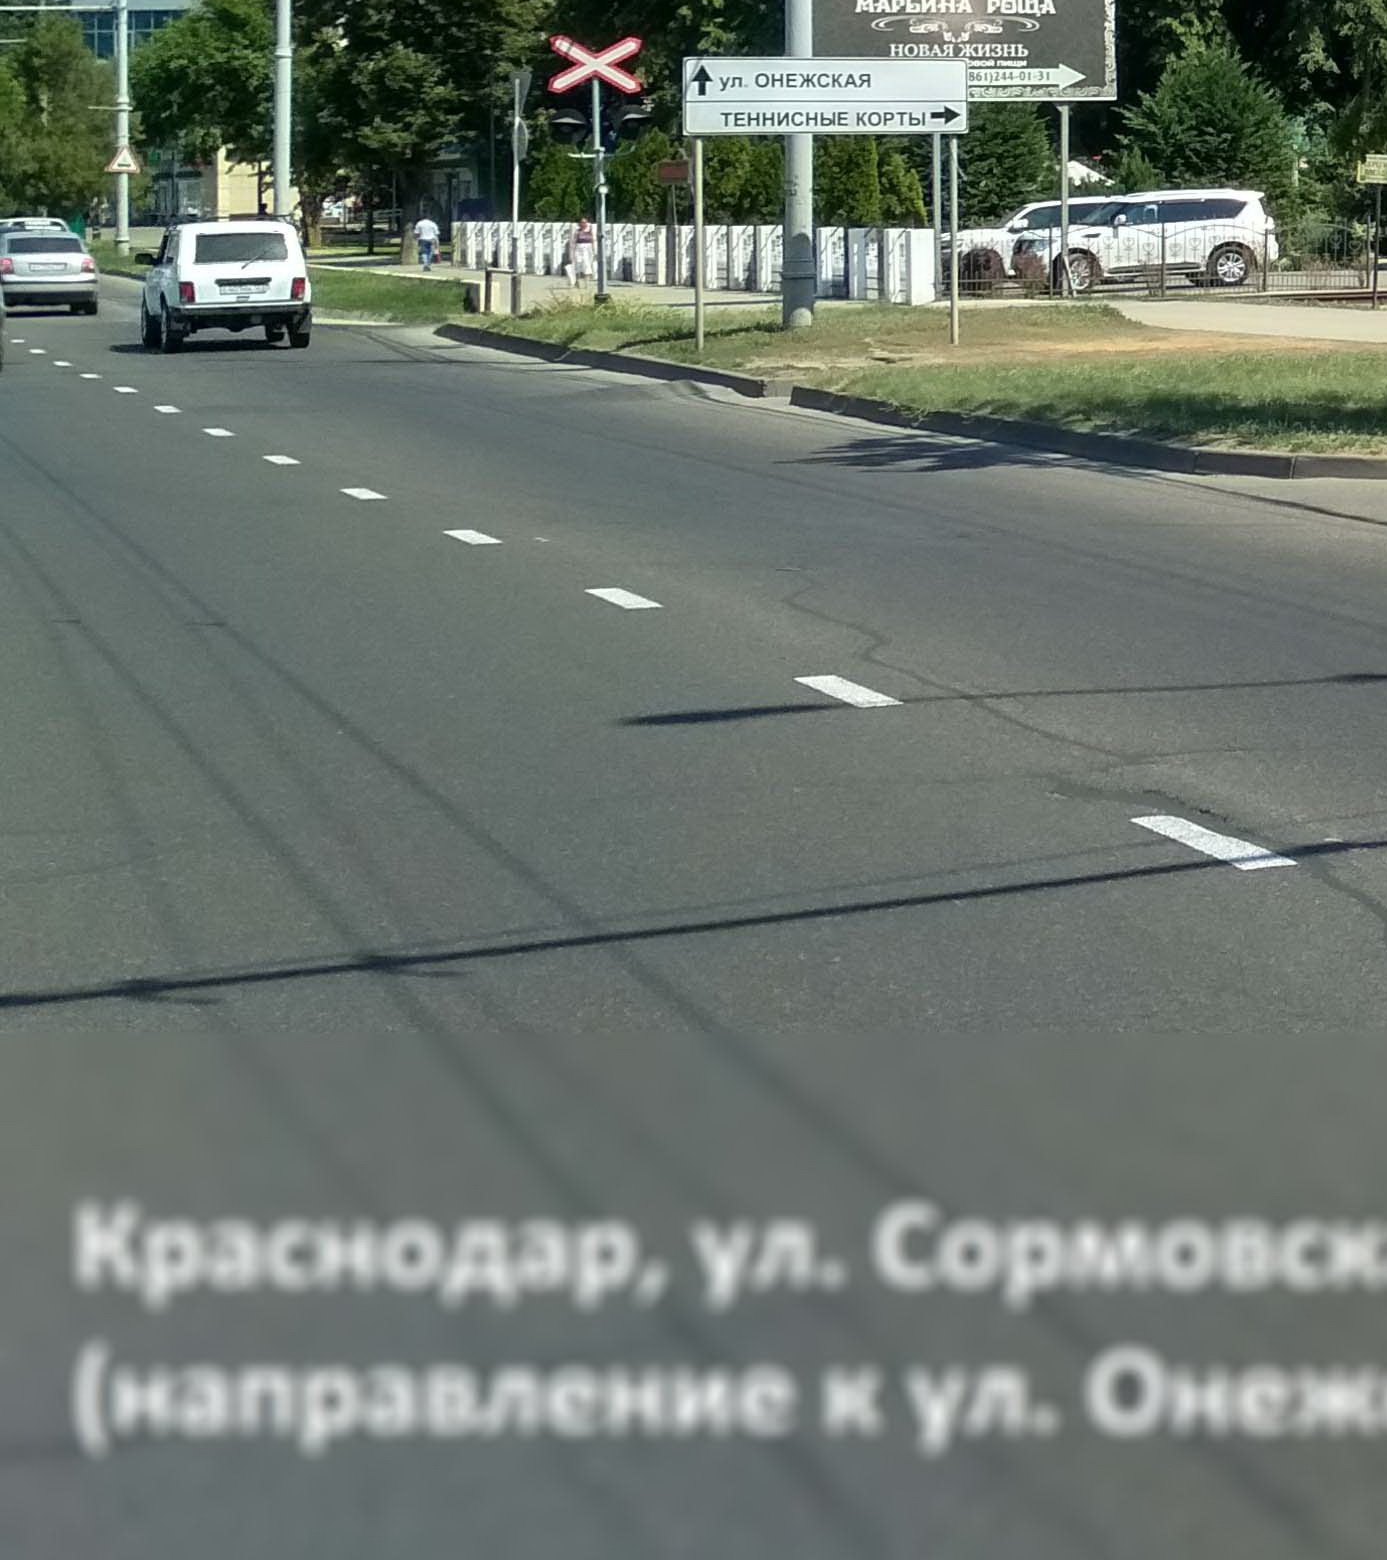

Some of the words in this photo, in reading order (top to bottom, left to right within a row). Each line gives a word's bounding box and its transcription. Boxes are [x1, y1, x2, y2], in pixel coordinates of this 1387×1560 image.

[888, 43, 955, 57] НОВАЯ
[958, 43, 1030, 57] ЖИЗНЬ
[719, 75, 749, 91] ул.
[754, 73, 872, 88] ОНЕЖСКАЯ
[968, 70, 1051, 84] 861)244-01-31
[720, 111, 849, 127] ТЕННИСНЫЕ
[856, 111, 927, 127] КОРТЫ
